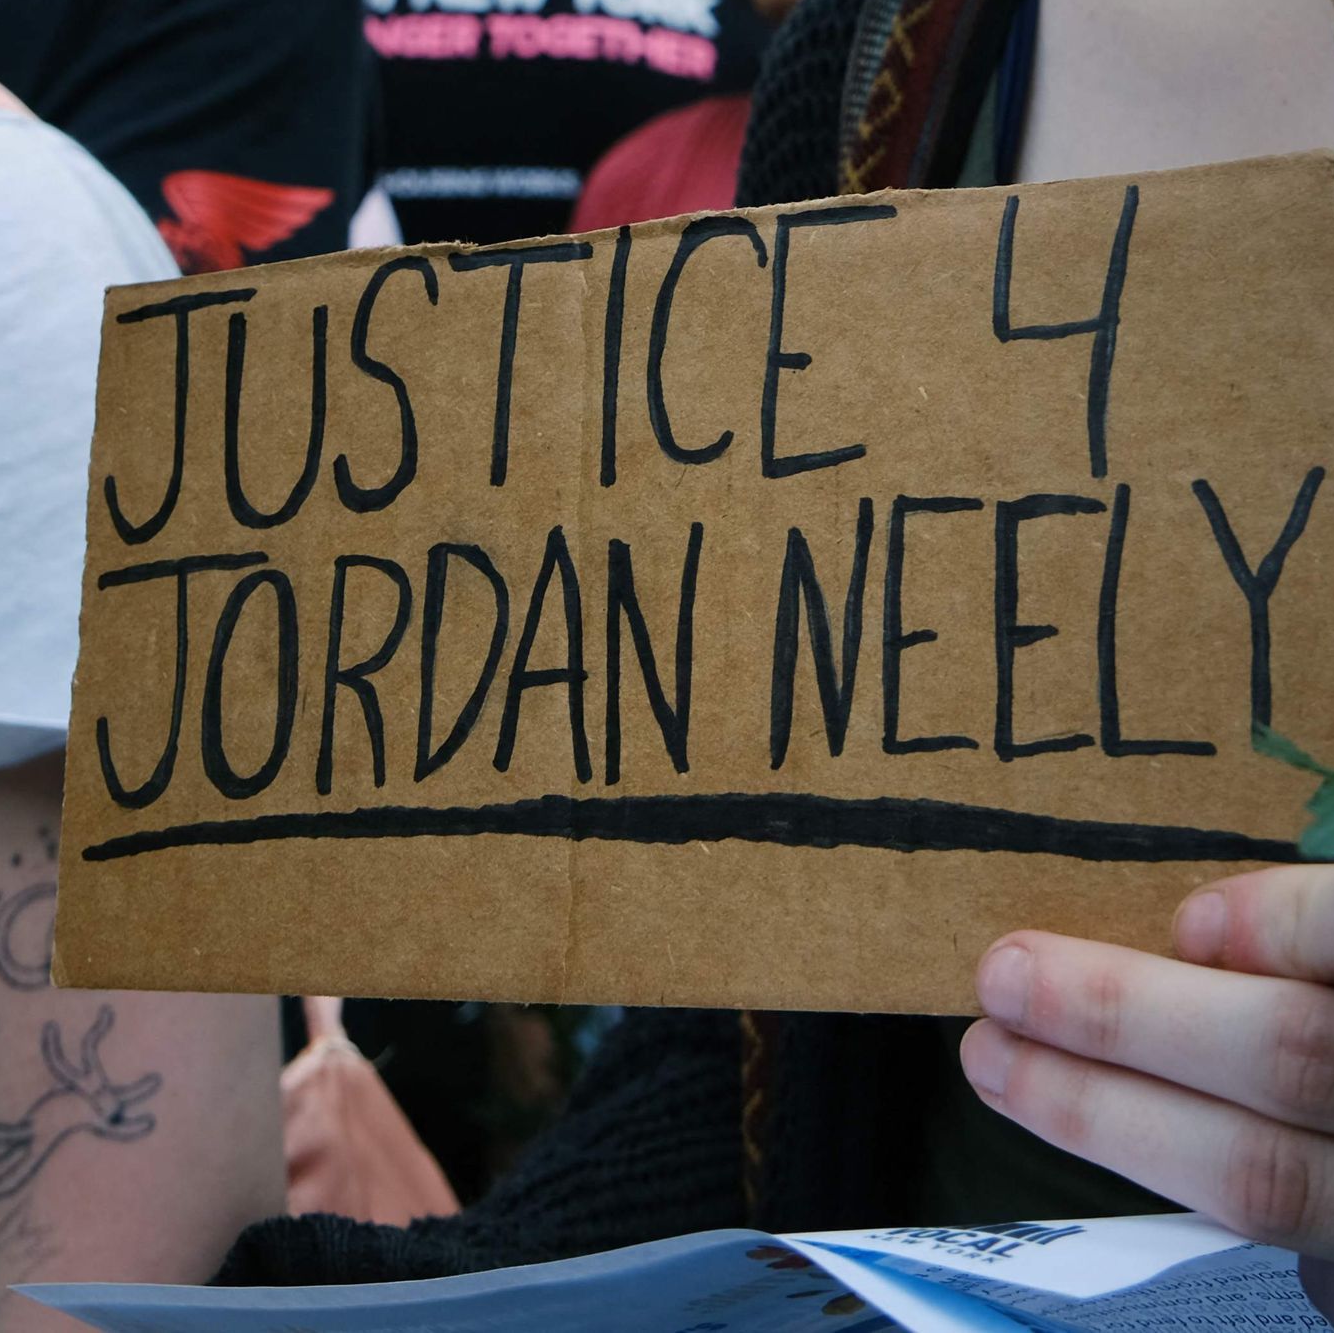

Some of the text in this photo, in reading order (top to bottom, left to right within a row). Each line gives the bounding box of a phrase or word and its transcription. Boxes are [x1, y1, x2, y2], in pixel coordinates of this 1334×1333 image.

[103, 184, 1140, 546] JUSTICE 4
[96, 467, 1326, 811] JORDAN NEELY
[865, 1233, 1004, 1264] NEW YORK
[1204, 1292, 1248, 1306] and
[1187, 1315, 1215, 1326] to
[1254, 1313, 1297, 1327] and
